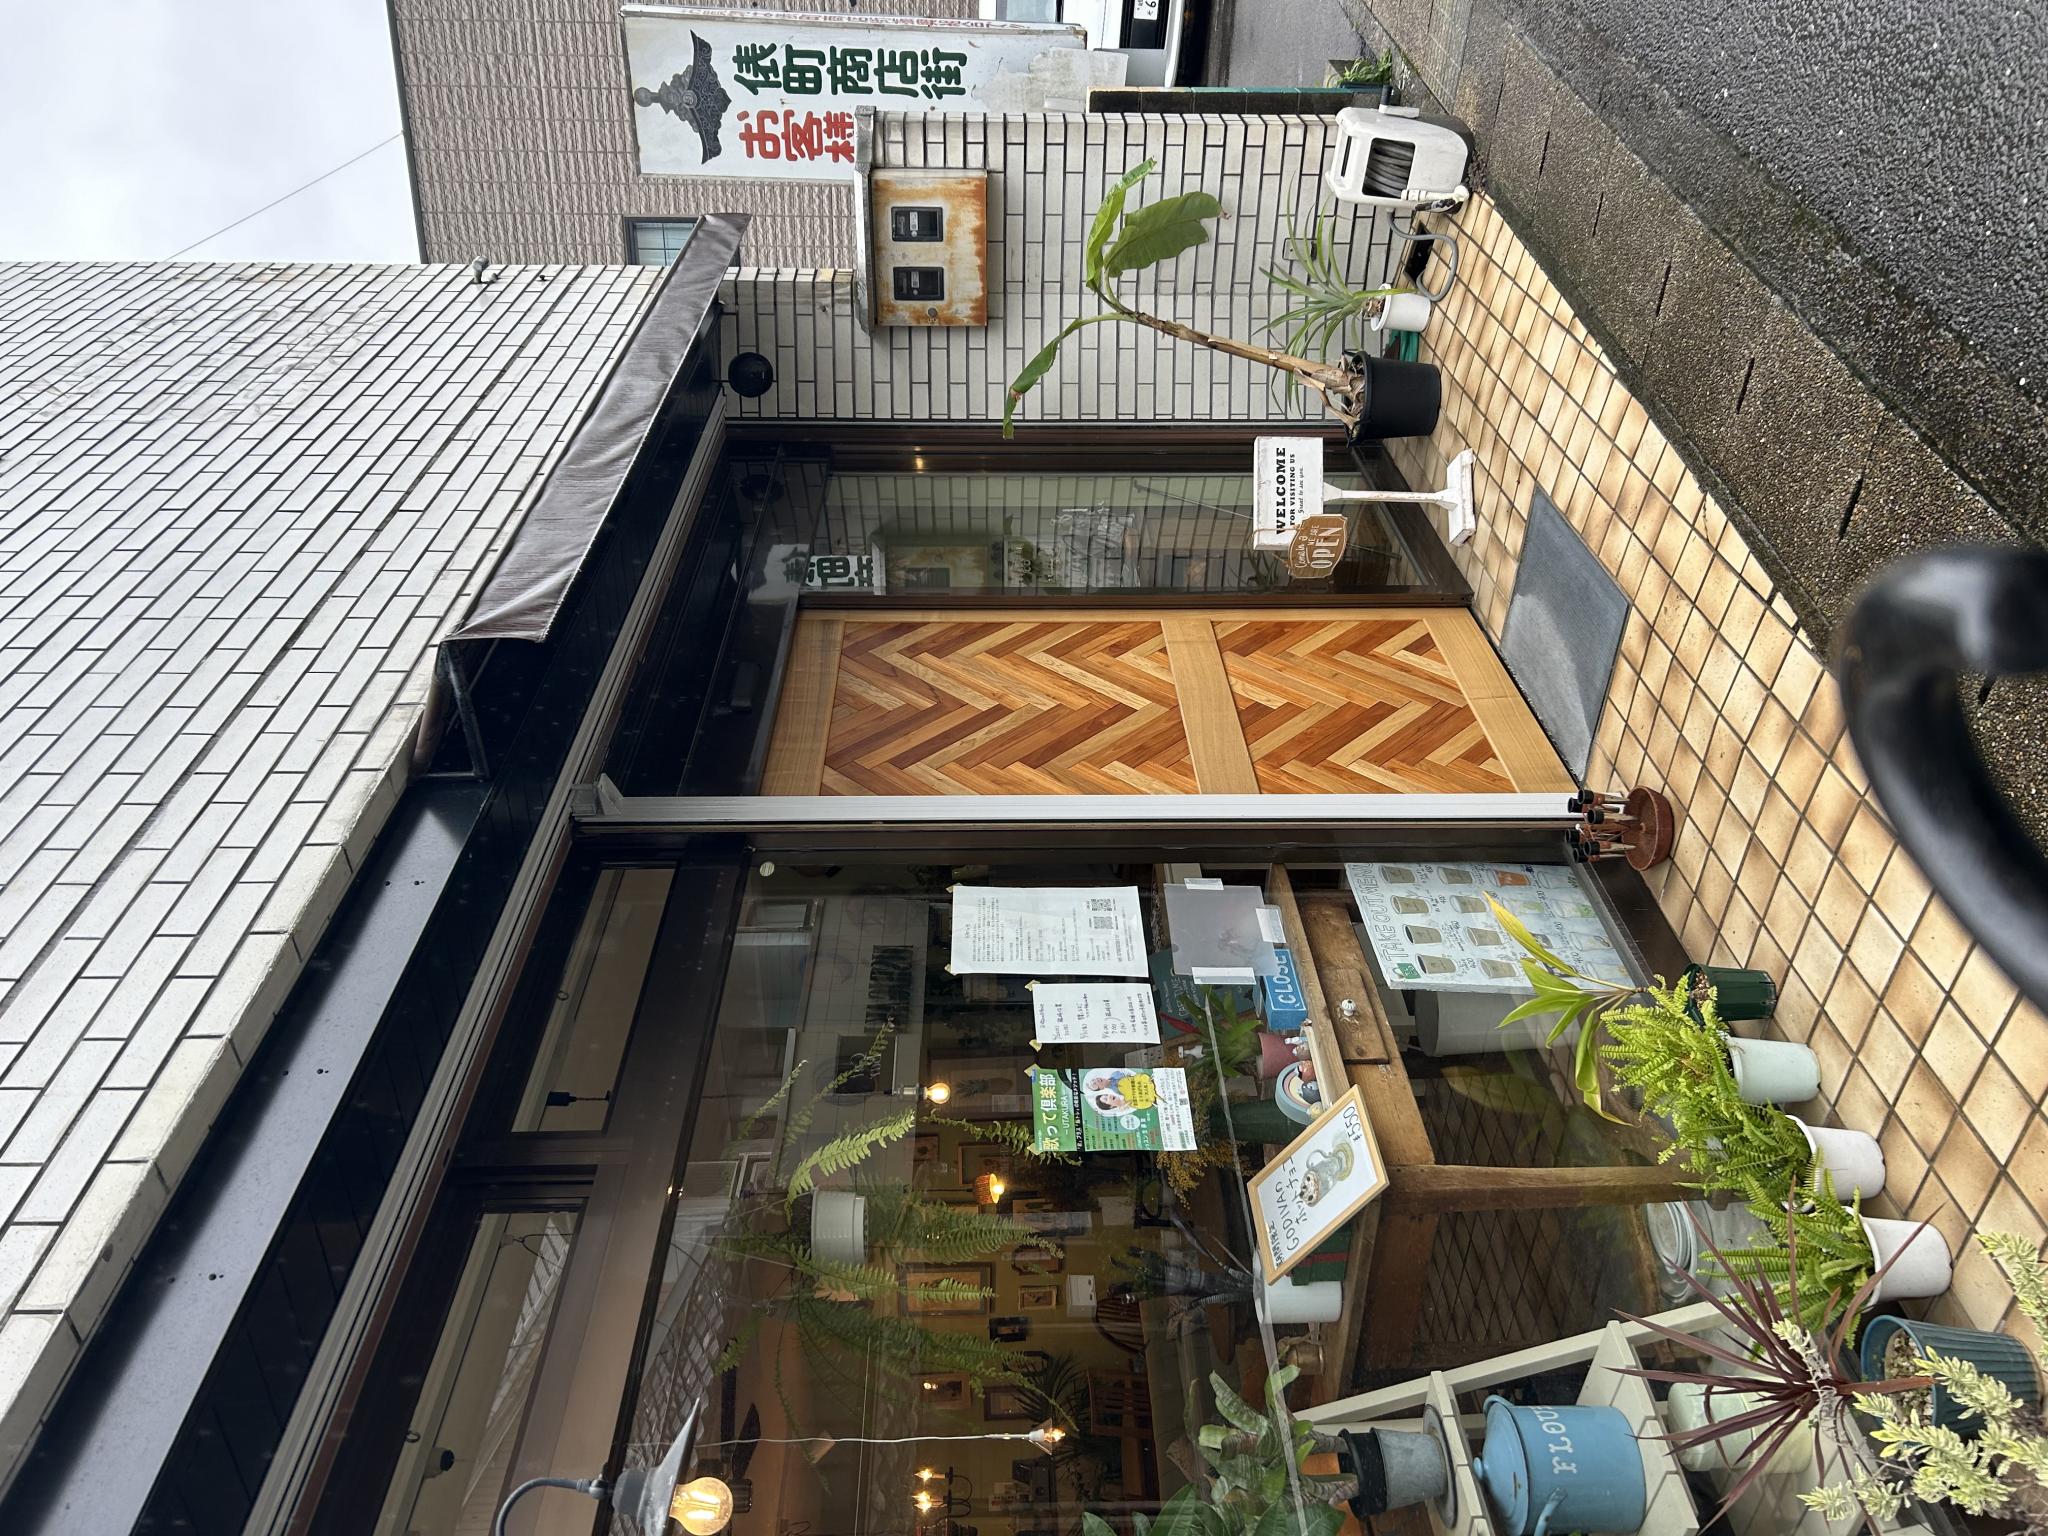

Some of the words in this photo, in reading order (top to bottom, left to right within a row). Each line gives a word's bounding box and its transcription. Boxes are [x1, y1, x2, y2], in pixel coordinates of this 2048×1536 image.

[733, 43, 968, 100] 俵町商店街
[737, 109, 854, 164] お客様
[1290, 454, 1296, 464] US
[1276, 447, 1286, 534] WELCOME
[1310, 527, 1343, 568] OPEN
[1363, 896, 1391, 923] OUT
[1374, 924, 1408, 962] TAKE
[1039, 1074, 1060, 1151] 歌って倶楽部
[1061, 1096, 1070, 1128] UTAKURA
[1342, 1106, 1362, 1141] ¥550
[1275, 1180, 1300, 1251] GODIVAの
